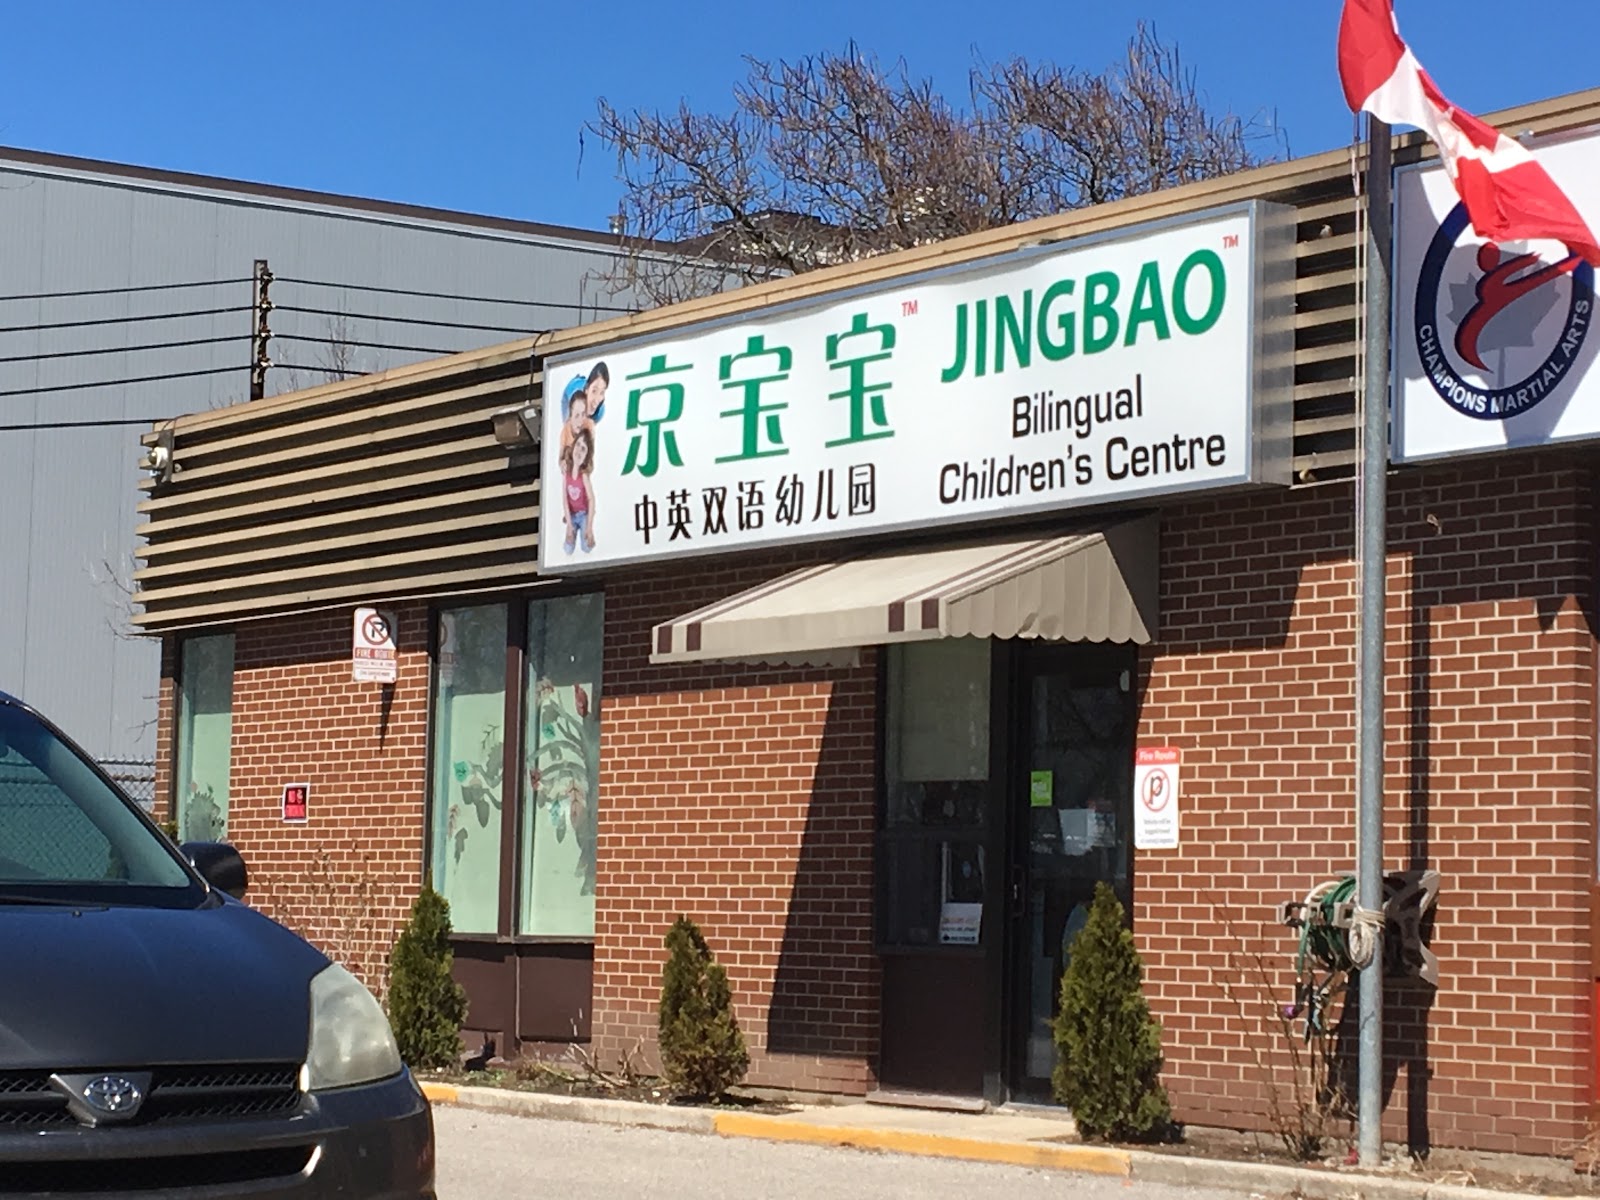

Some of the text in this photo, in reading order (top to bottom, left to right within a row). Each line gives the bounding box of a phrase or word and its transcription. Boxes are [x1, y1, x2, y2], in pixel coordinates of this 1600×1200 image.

[941, 248, 1227, 383] JINGBAO
[1419, 300, 1590, 414] CHAMPIONS MARTIAL ARTS
[621, 313, 897, 478] 京宝宝
[1012, 374, 1144, 441] Bilingual
[634, 461, 877, 545] 中英双语幼儿园
[939, 434, 1227, 505] Children's Centre
